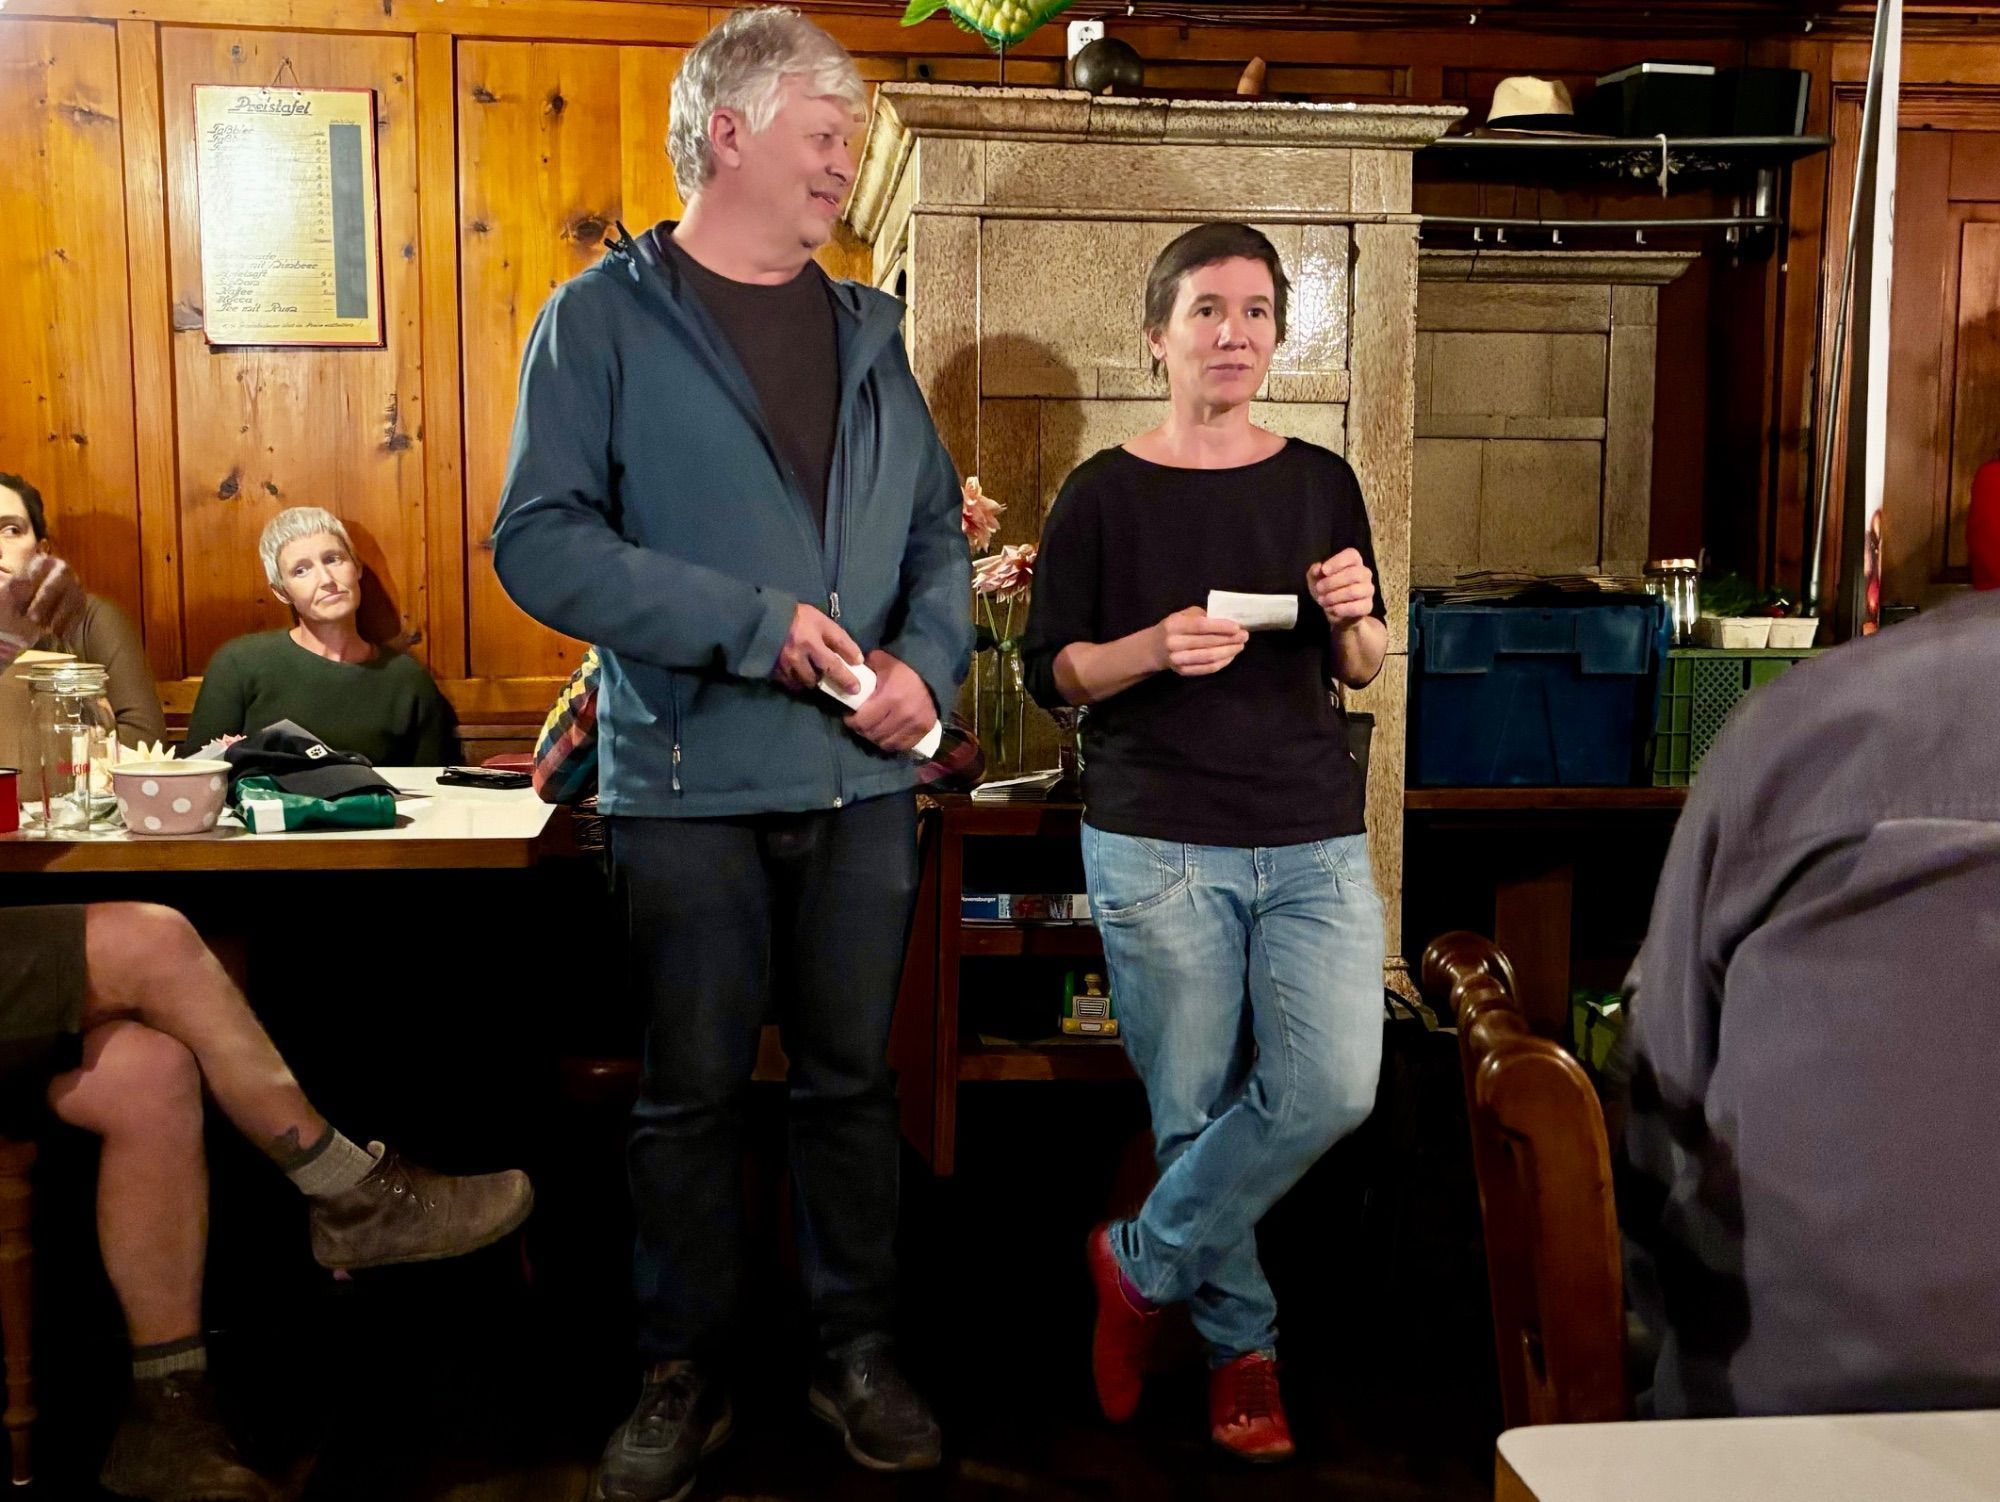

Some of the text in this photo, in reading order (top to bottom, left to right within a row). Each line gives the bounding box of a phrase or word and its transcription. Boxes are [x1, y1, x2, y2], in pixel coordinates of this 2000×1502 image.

[228, 95, 312, 116] Preistafel
[242, 303, 261, 312] mit
[265, 302, 298, 312] Rum
